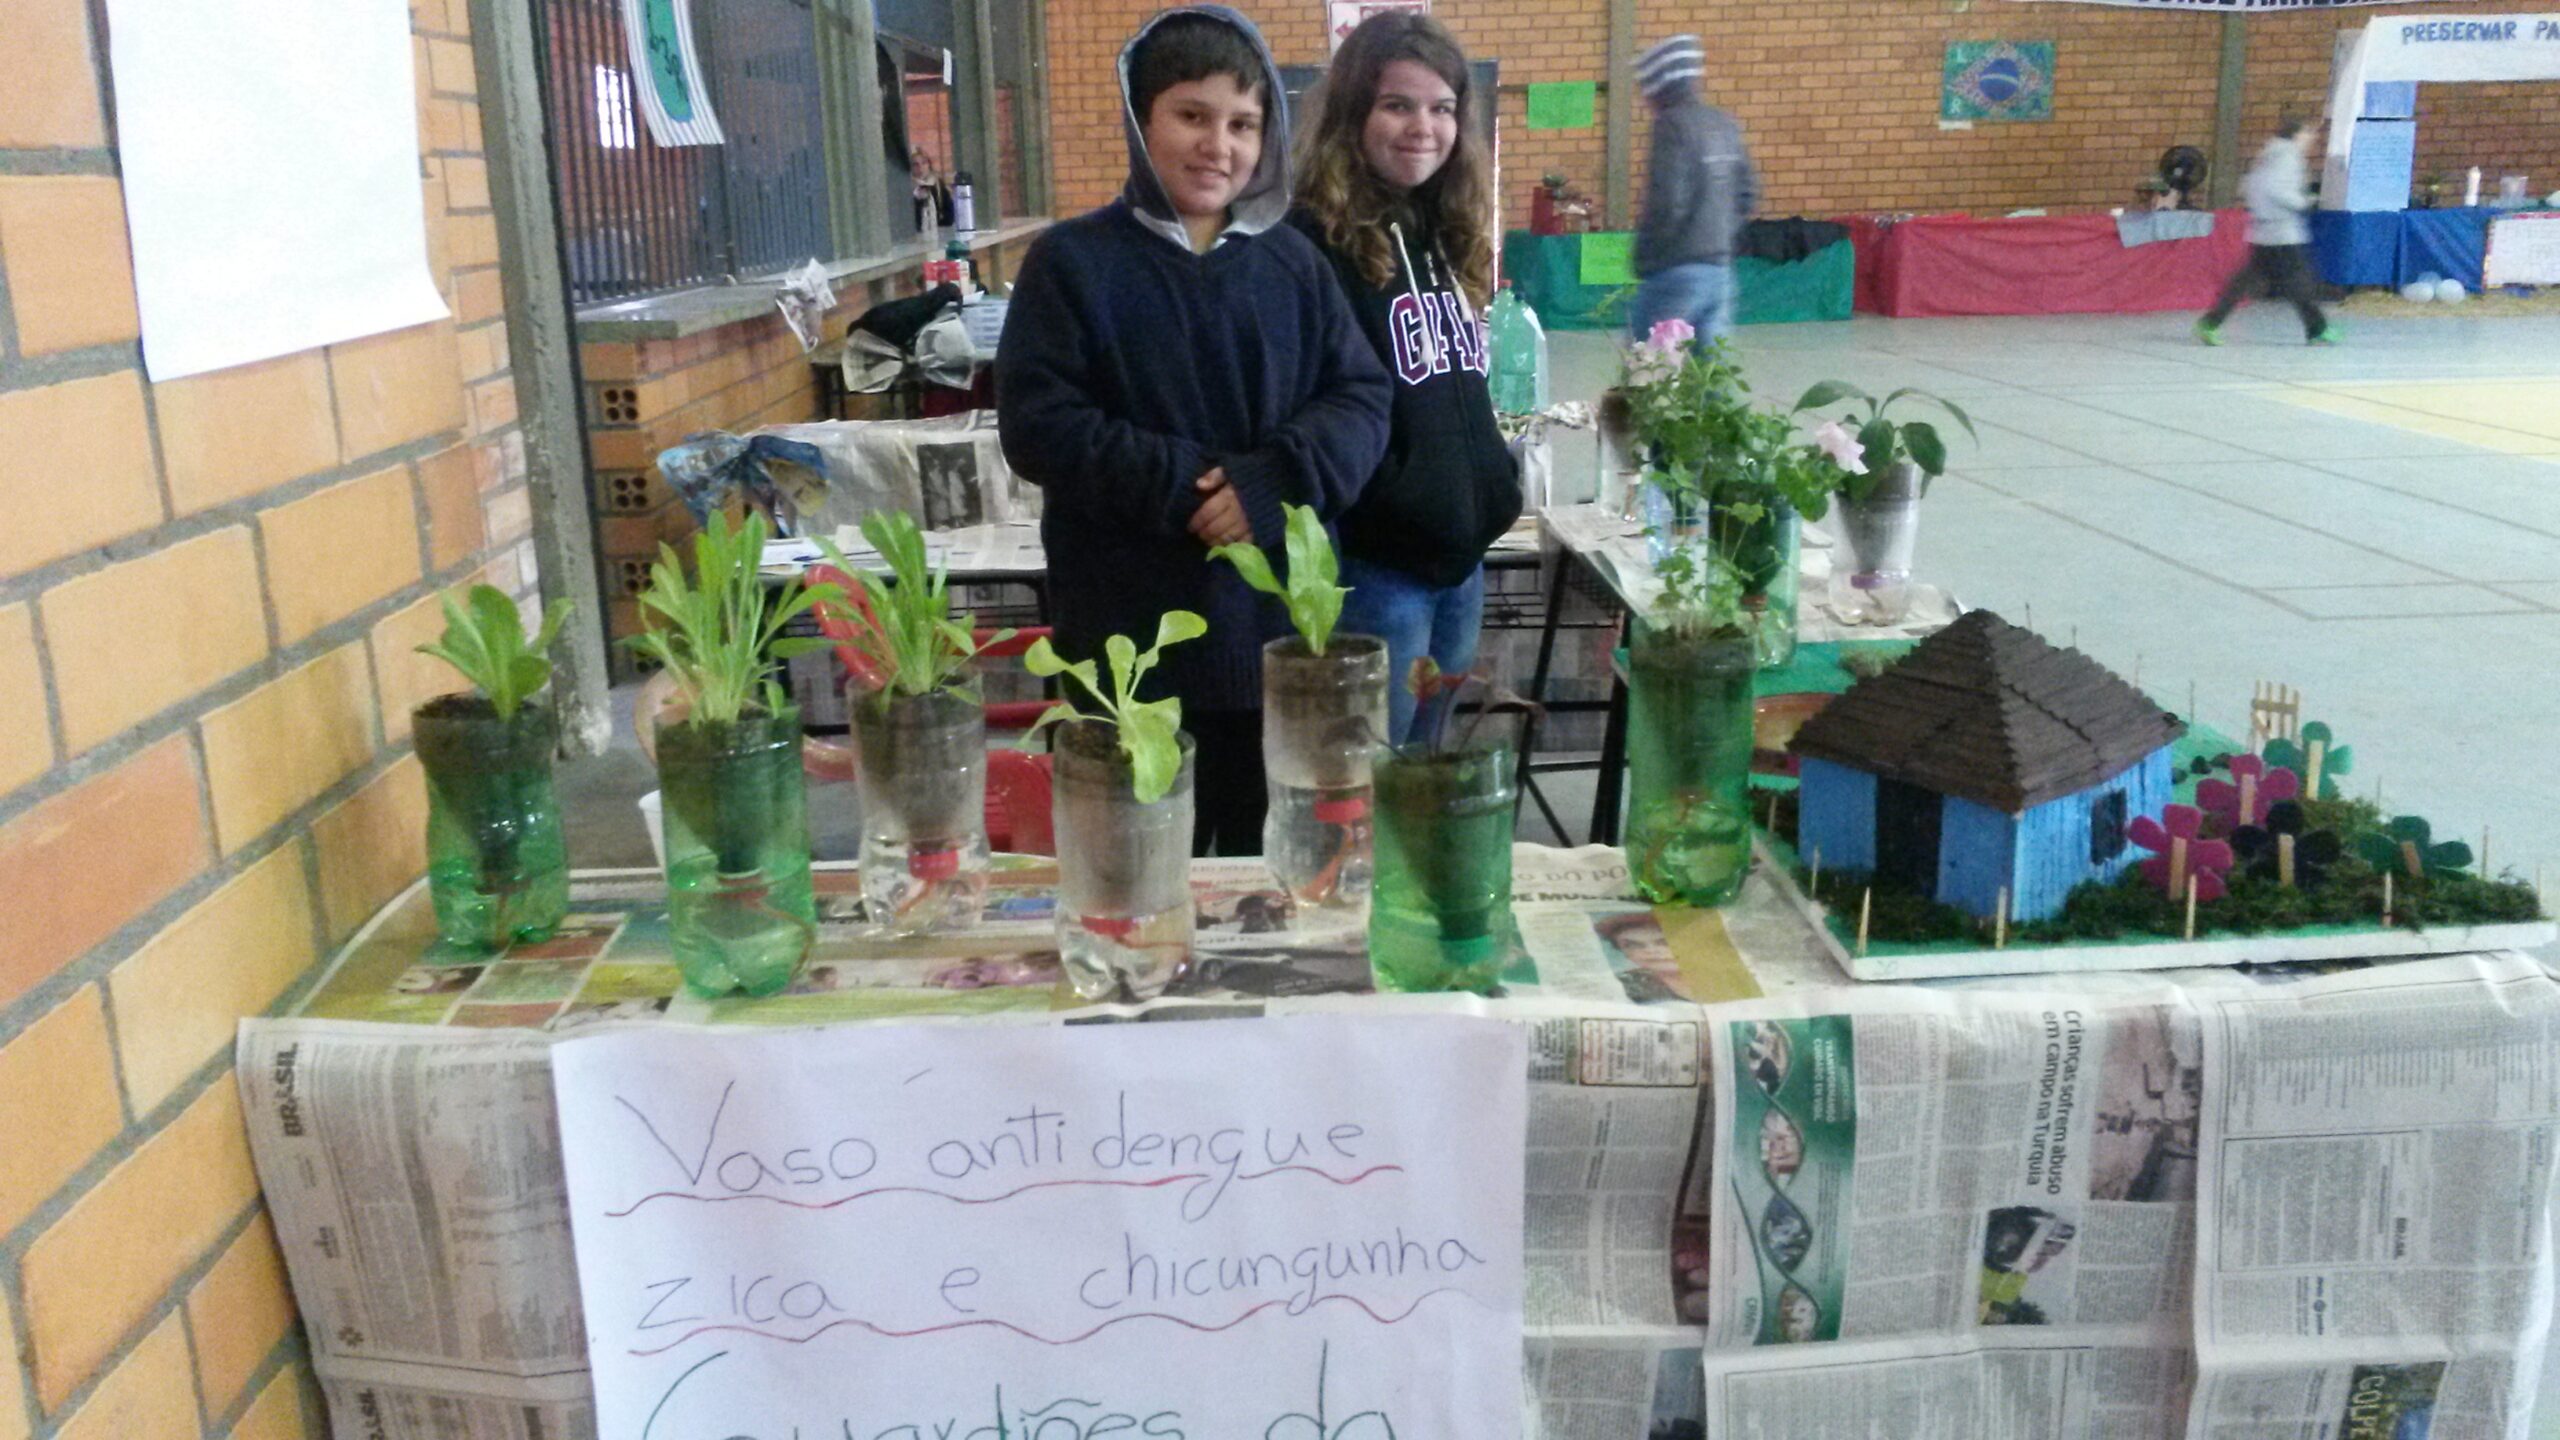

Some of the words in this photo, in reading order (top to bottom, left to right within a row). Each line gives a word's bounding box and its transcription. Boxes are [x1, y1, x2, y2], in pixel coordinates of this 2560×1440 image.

[2402, 21, 2517, 45] PRESERVAR
[2042, 1011, 2062, 1038] em
[2062, 1010, 2085, 1082] Crianças
[271, 1041, 305, 1138] BRASIL
[2039, 1042, 2062, 1099] campo
[2036, 1101, 2052, 1121] na
[2053, 1084, 2078, 1142] sofrem
[614, 1079, 877, 1193] Vaso
[928, 1104, 1066, 1179] anti
[1092, 1090, 1365, 1223] dengue
[2026, 1121, 2051, 1186] Turquia
[2046, 1145, 2068, 1195] abuso
[939, 1266, 981, 1314] e
[1079, 1226, 1487, 1317] chicungunha
[357, 1387, 385, 1440] RASIL
[643, 1350, 1186, 1440] Grdiões
